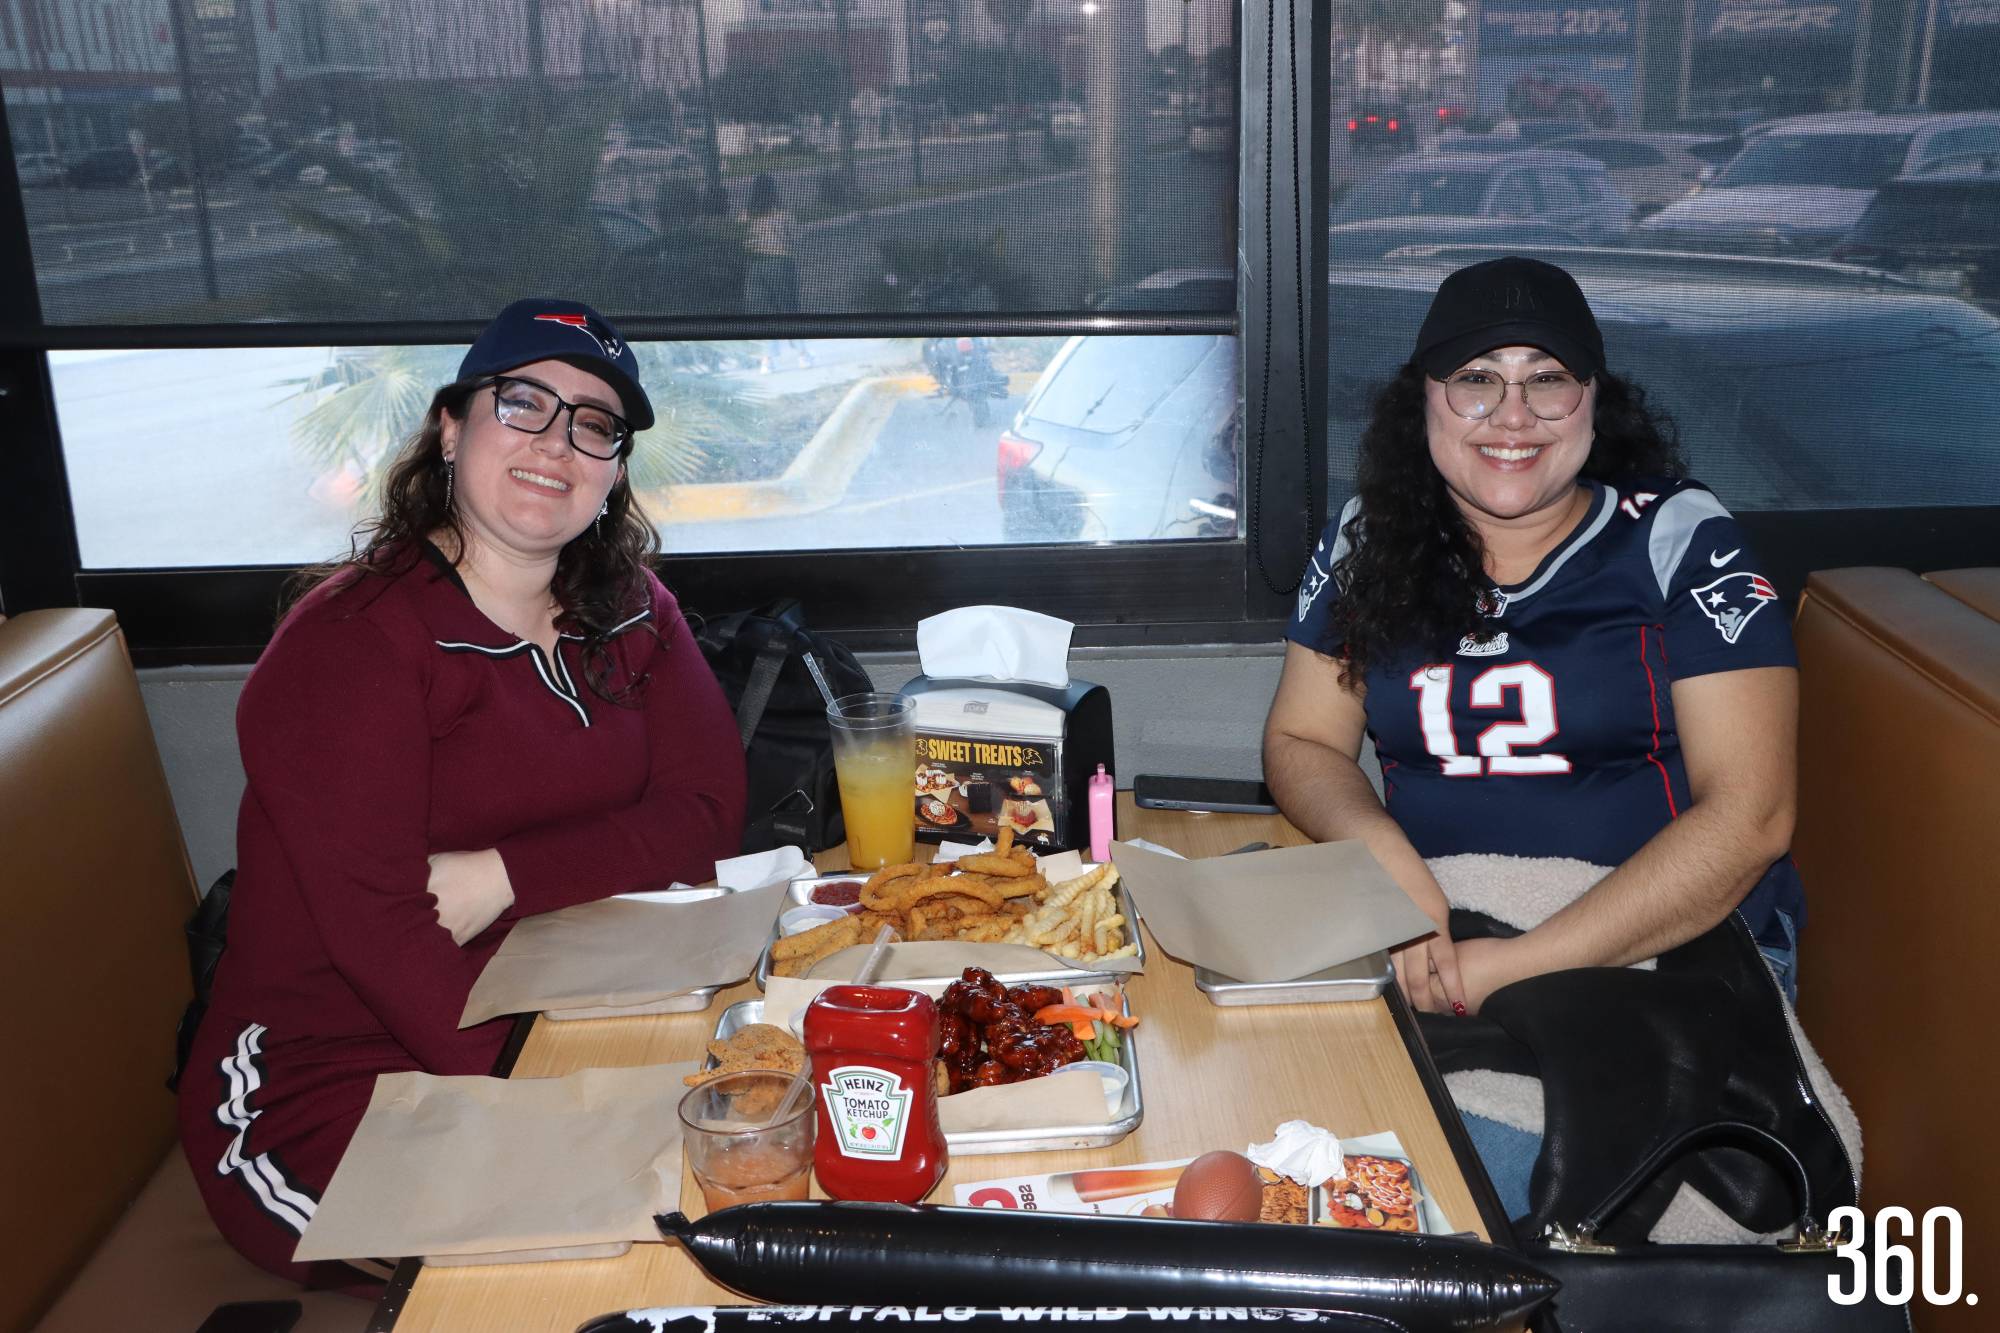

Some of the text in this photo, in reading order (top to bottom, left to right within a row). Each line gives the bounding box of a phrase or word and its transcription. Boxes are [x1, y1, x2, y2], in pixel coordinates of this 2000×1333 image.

[1563, 9, 1629, 35] 20%
[1409, 660, 1573, 777] 12
[927, 739, 1023, 767] SWEET TREATS
[844, 1078, 884, 1092] HEINZ
[843, 1096, 890, 1110] TOMATO
[846, 1108, 889, 1119] KETCHUP
[1018, 1184, 1038, 1210] 982
